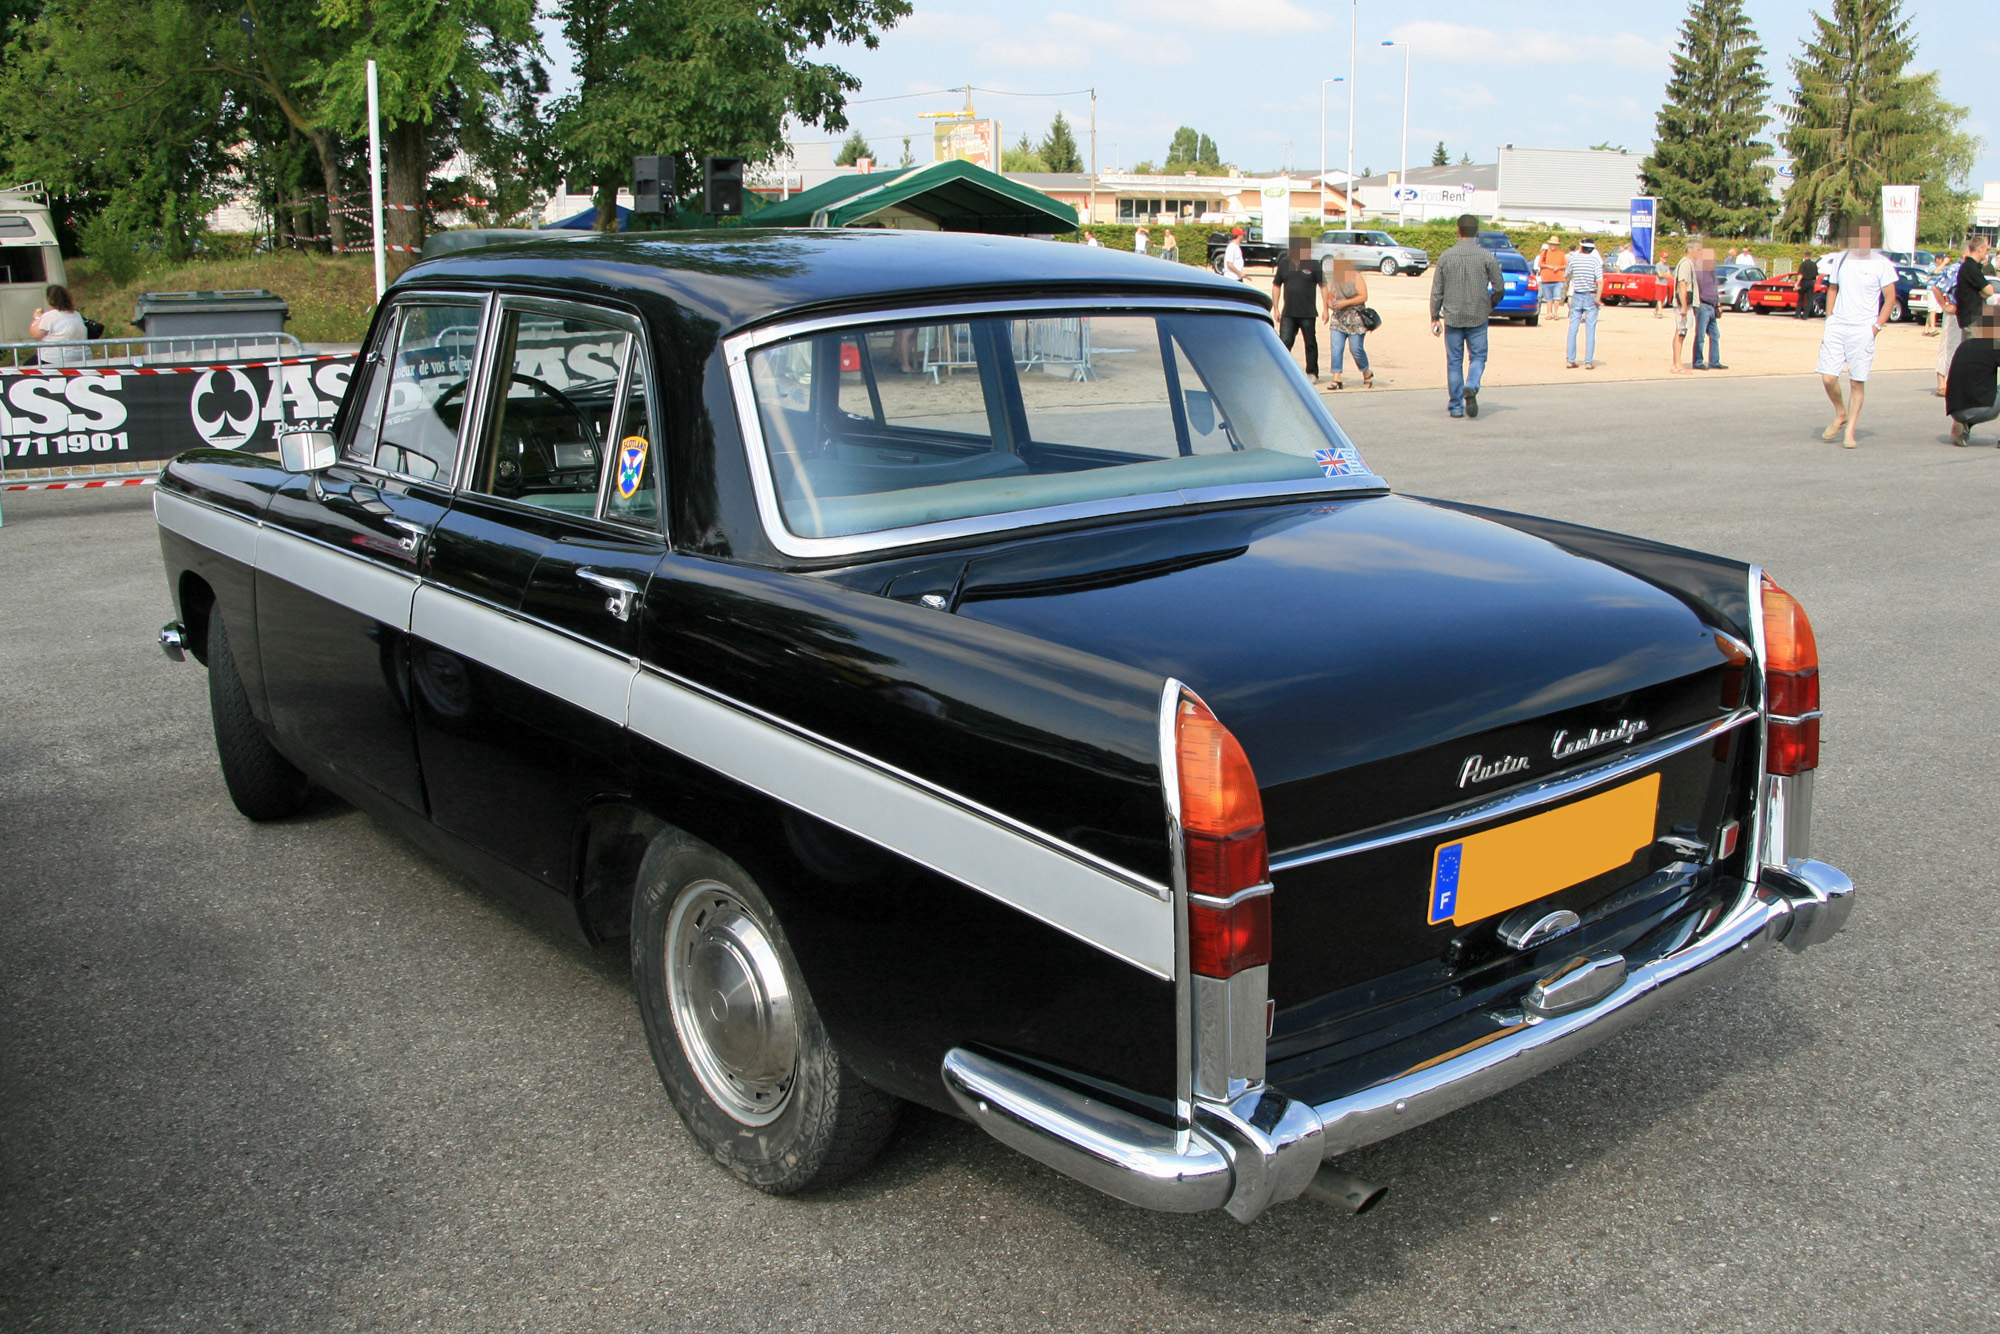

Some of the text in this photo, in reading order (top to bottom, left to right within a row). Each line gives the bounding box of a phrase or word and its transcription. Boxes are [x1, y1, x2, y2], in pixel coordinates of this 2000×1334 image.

[419, 359, 429, 375] de
[430, 361, 446, 374] vos
[0, 375, 128, 436] SS
[623, 439, 647, 452] SCOTLAND
[1458, 719, 1649, 789] Austin Cambridge
[1440, 891, 1452, 910] F
